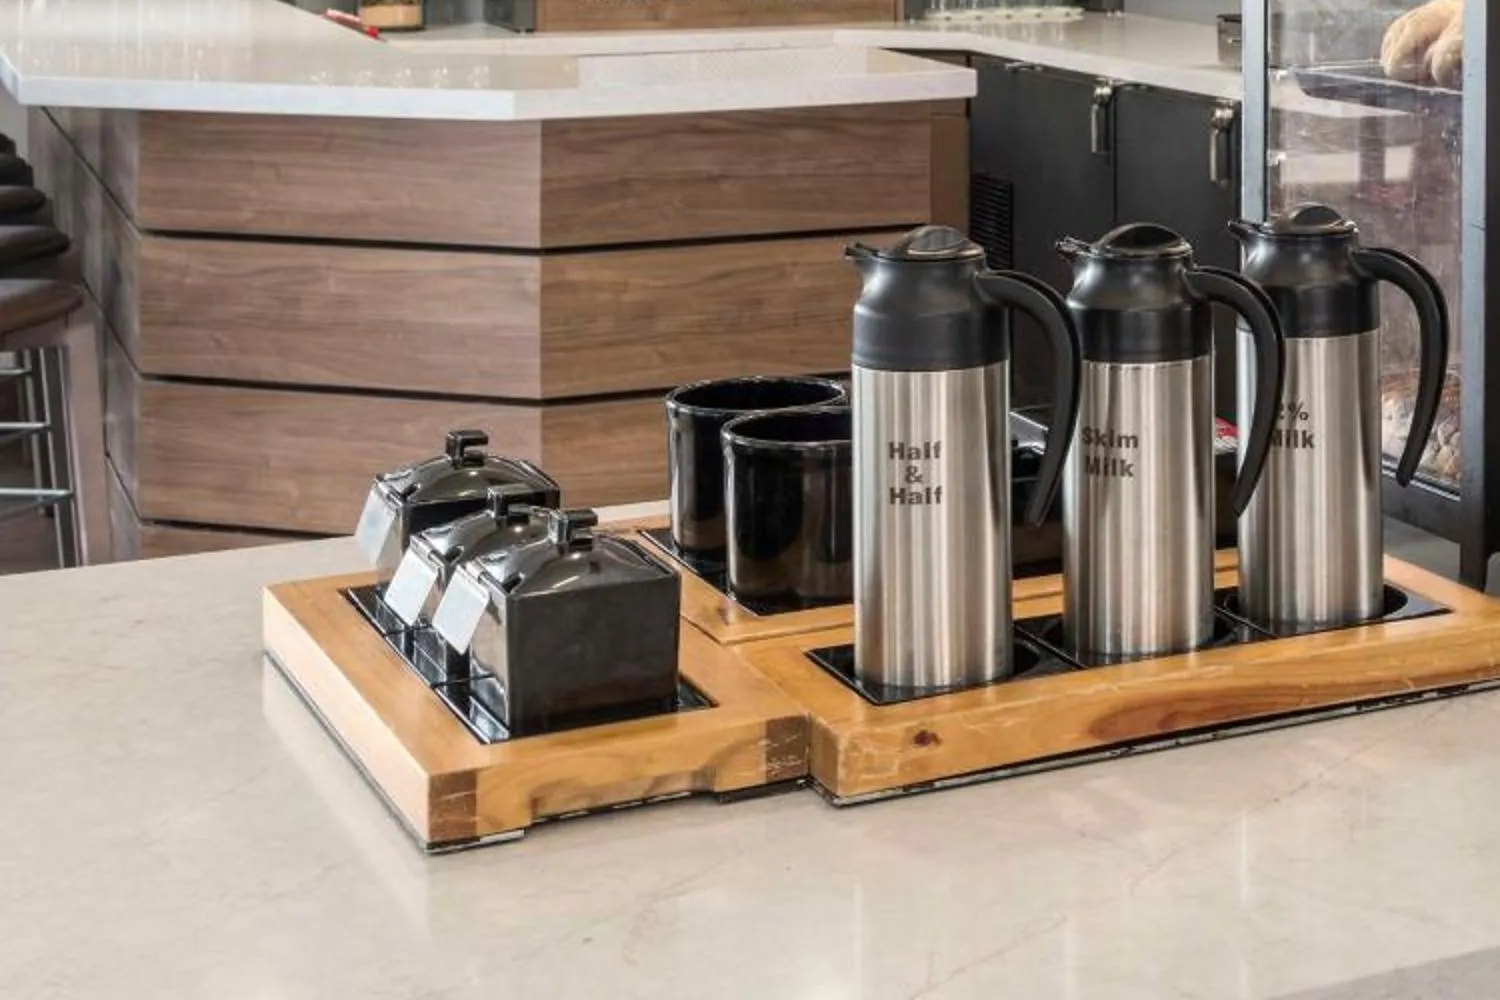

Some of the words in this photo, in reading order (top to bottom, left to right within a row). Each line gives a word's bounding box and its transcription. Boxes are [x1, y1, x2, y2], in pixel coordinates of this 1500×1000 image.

[1083, 426, 1139, 448] Skim
[889, 441, 941, 460] Half
[905, 466, 923, 484] &
[1085, 456, 1134, 477] Milk
[889, 487, 942, 504] Half
